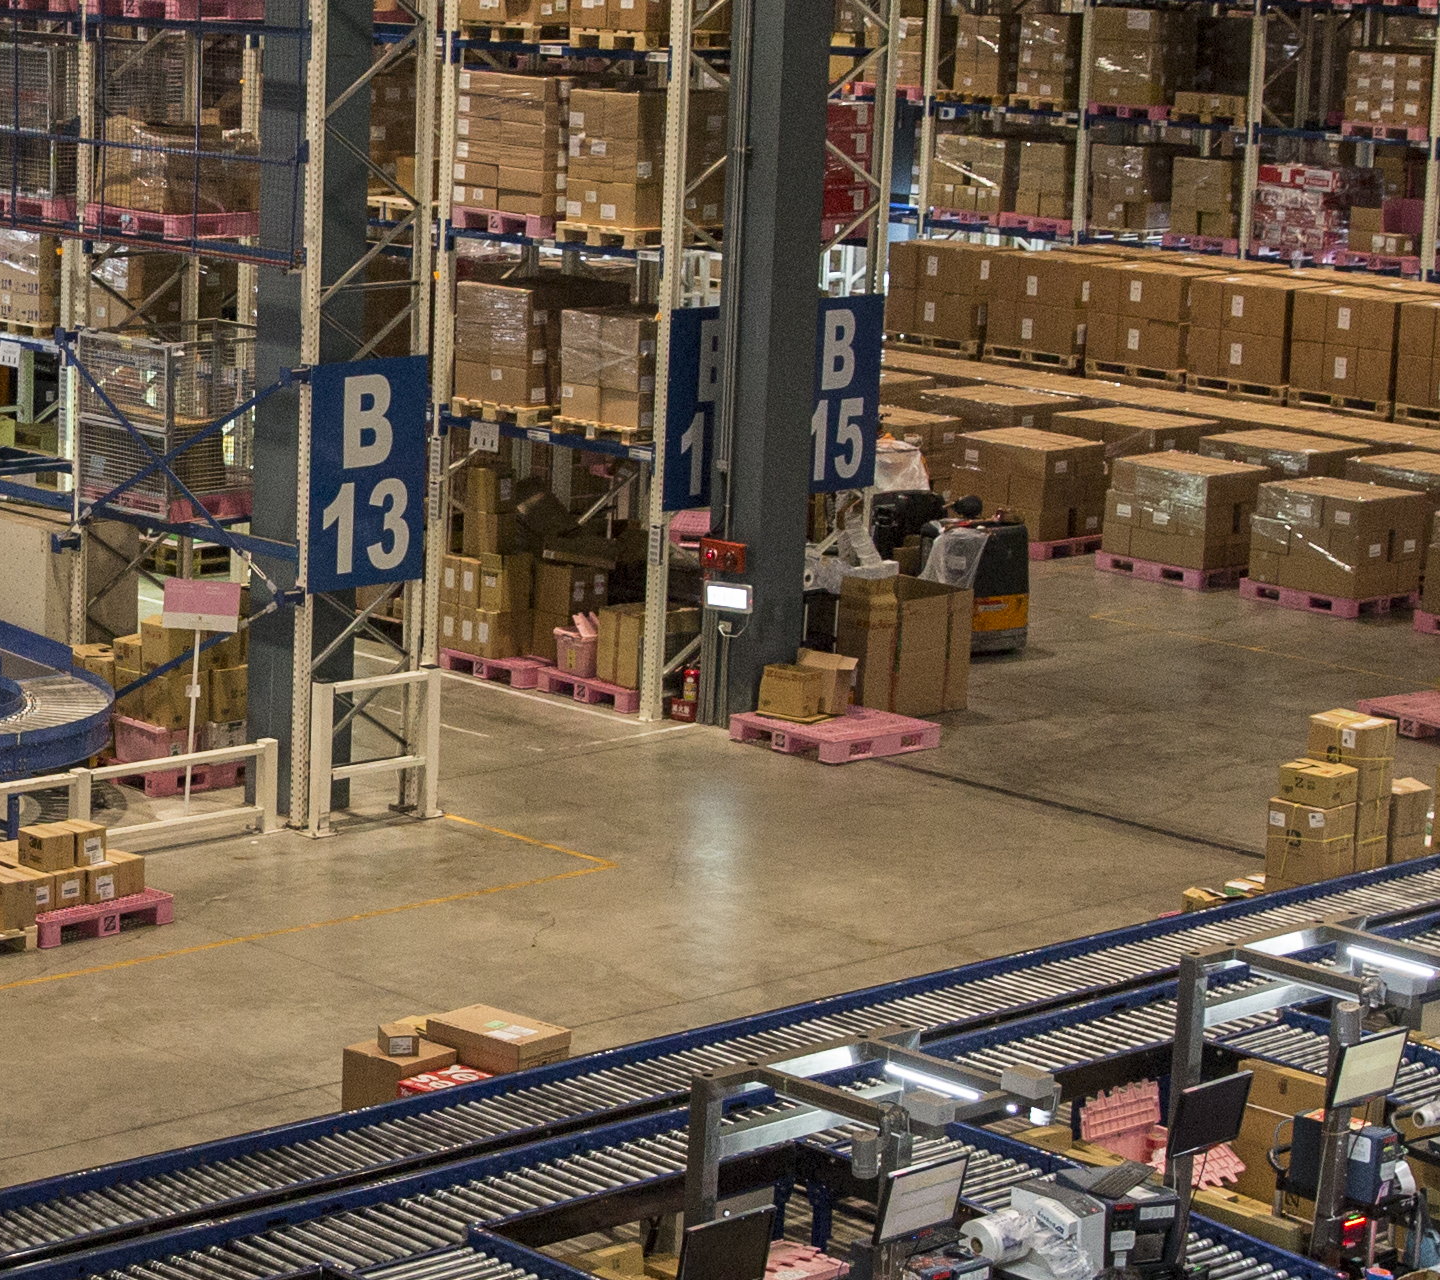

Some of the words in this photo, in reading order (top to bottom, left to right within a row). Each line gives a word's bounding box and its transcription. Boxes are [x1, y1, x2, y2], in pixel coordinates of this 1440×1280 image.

[823, 307, 858, 391] B
[343, 373, 394, 470] B
[810, 398, 864, 480] 15
[322, 477, 410, 576] 13
